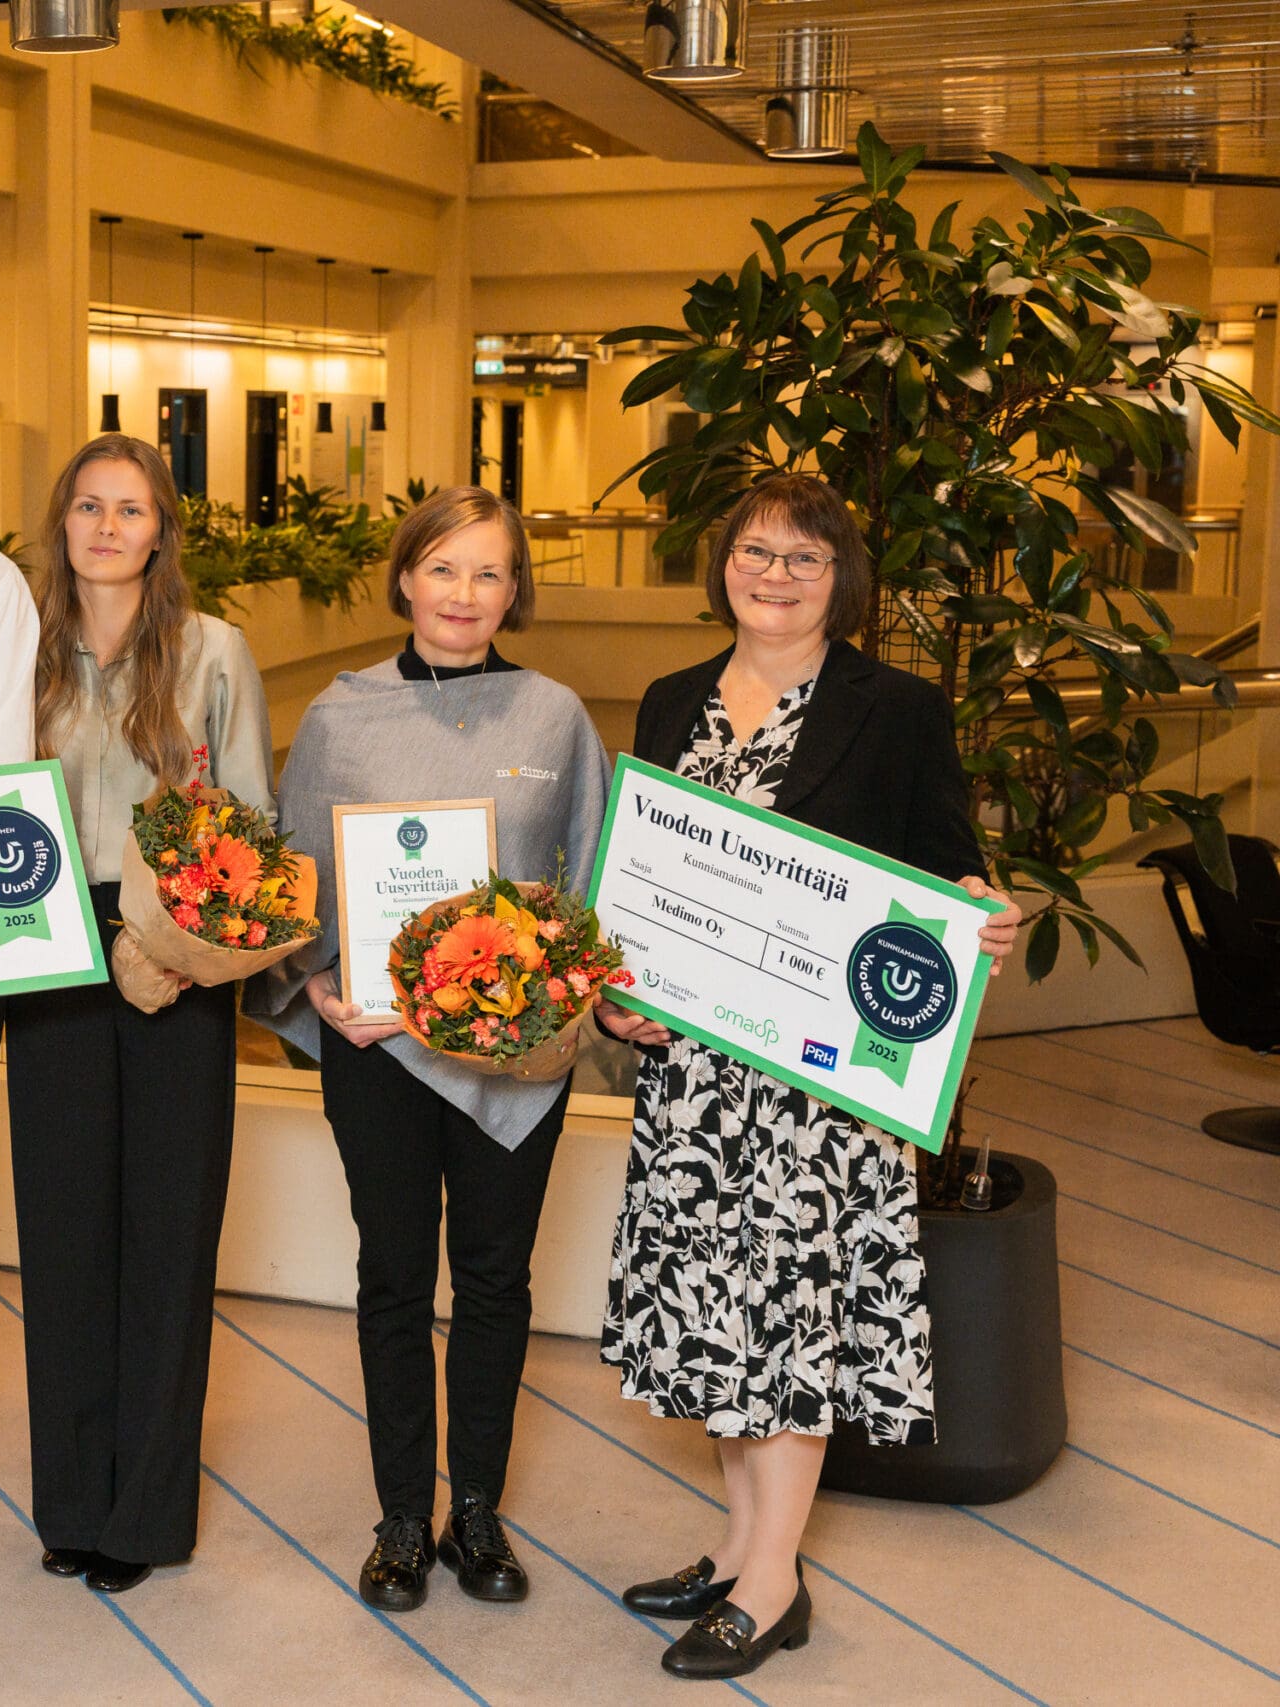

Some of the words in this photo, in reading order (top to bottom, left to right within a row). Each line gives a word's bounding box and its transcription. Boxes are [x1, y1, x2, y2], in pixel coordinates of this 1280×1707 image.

[634, 794, 713, 846] Vuoden
[720, 829, 849, 902] Uusyrittäjä
[2, 840, 50, 894] Uusyrittäjä
[388, 866, 444, 880] Vuoden
[628, 857, 652, 874] Saaja
[683, 852, 763, 895] Kunniamaininta
[376, 879, 459, 896] Uusyrittäjä
[4, 914, 36, 928] 2025
[652, 894, 702, 927] Medimo
[706, 918, 726, 938] Oy
[610, 929, 649, 952] Lhjoittajat
[776, 919, 810, 942] Summa
[778, 950, 785, 964] 1
[789, 955, 814, 976] 000
[816, 967, 826, 981] €
[877, 938, 940, 970] KUNNIAMAININTA
[860, 954, 879, 1010] Vuoden
[881, 982, 946, 1030] Uusyrittäjä
[804, 1044, 835, 1066] PRH
[867, 1040, 899, 1063] 2025
